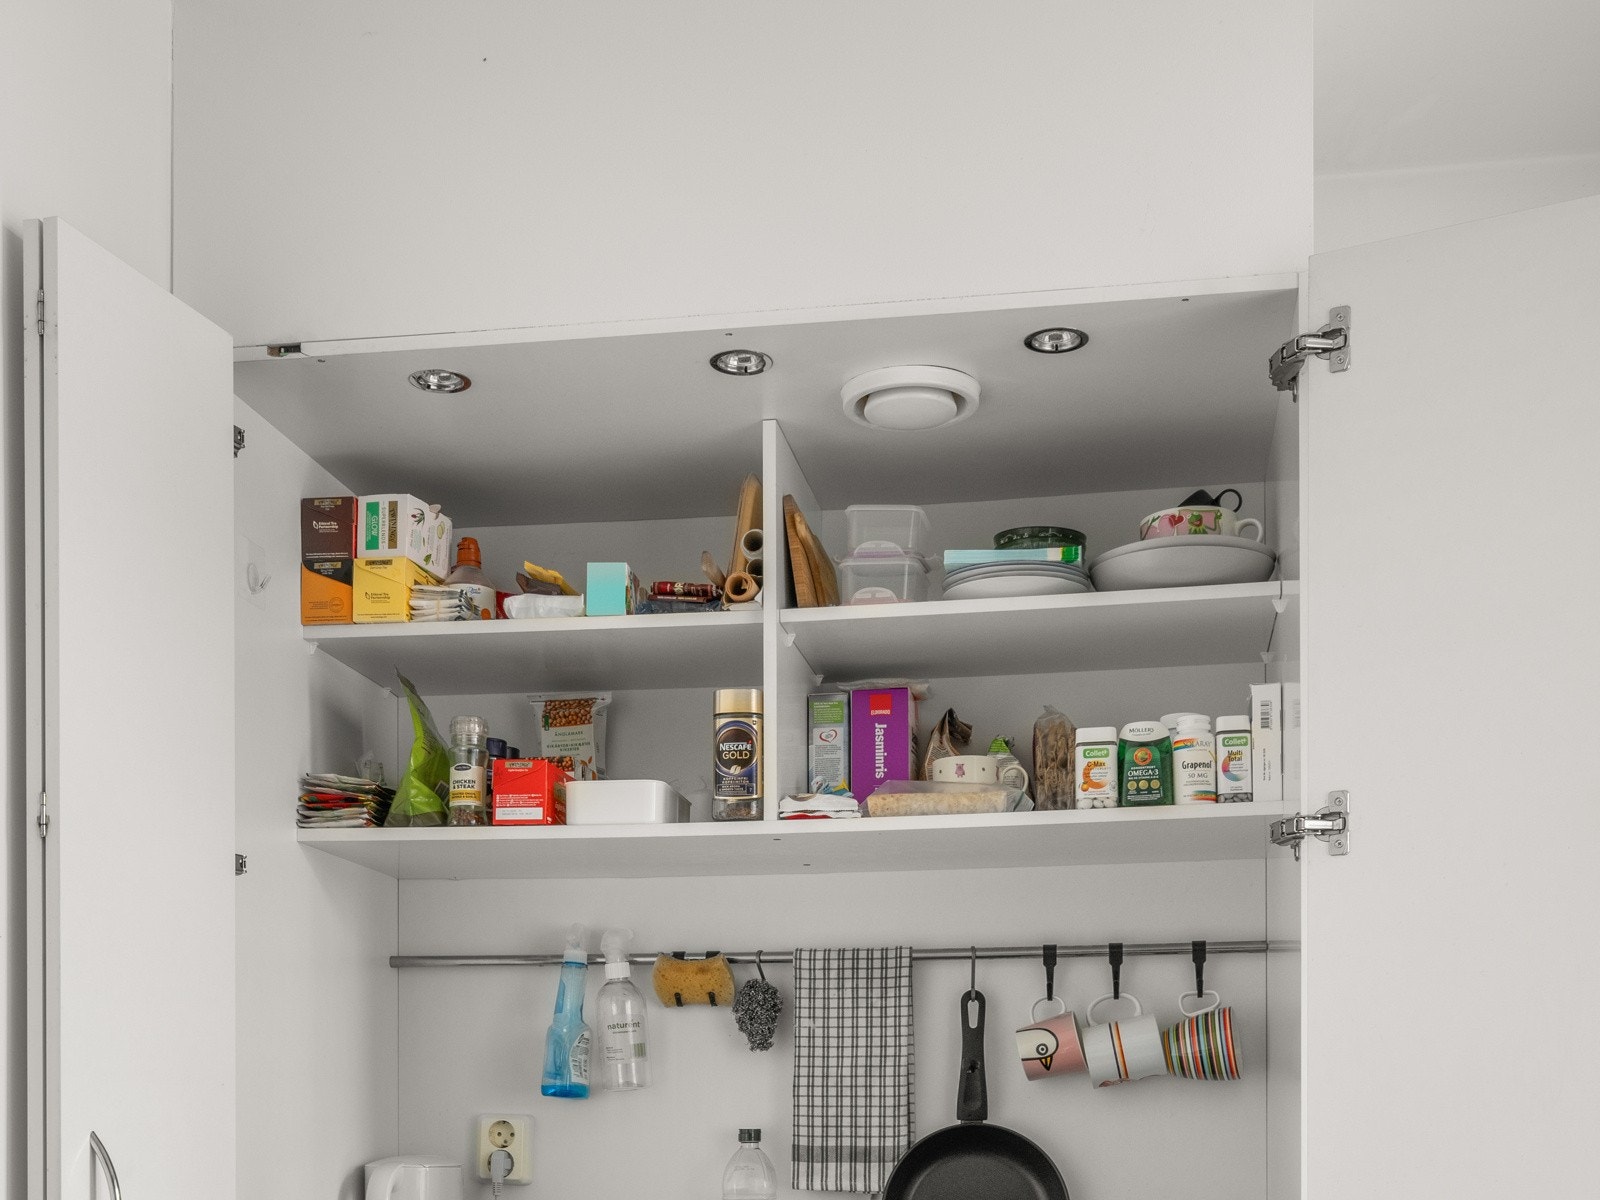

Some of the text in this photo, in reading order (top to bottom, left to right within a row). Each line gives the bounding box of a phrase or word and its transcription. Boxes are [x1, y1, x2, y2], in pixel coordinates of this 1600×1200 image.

[371, 515, 379, 536] GLOW
[722, 751, 750, 760] GOLD
[875, 723, 888, 779] Jasminris
[1182, 760, 1212, 770] Grapenol
